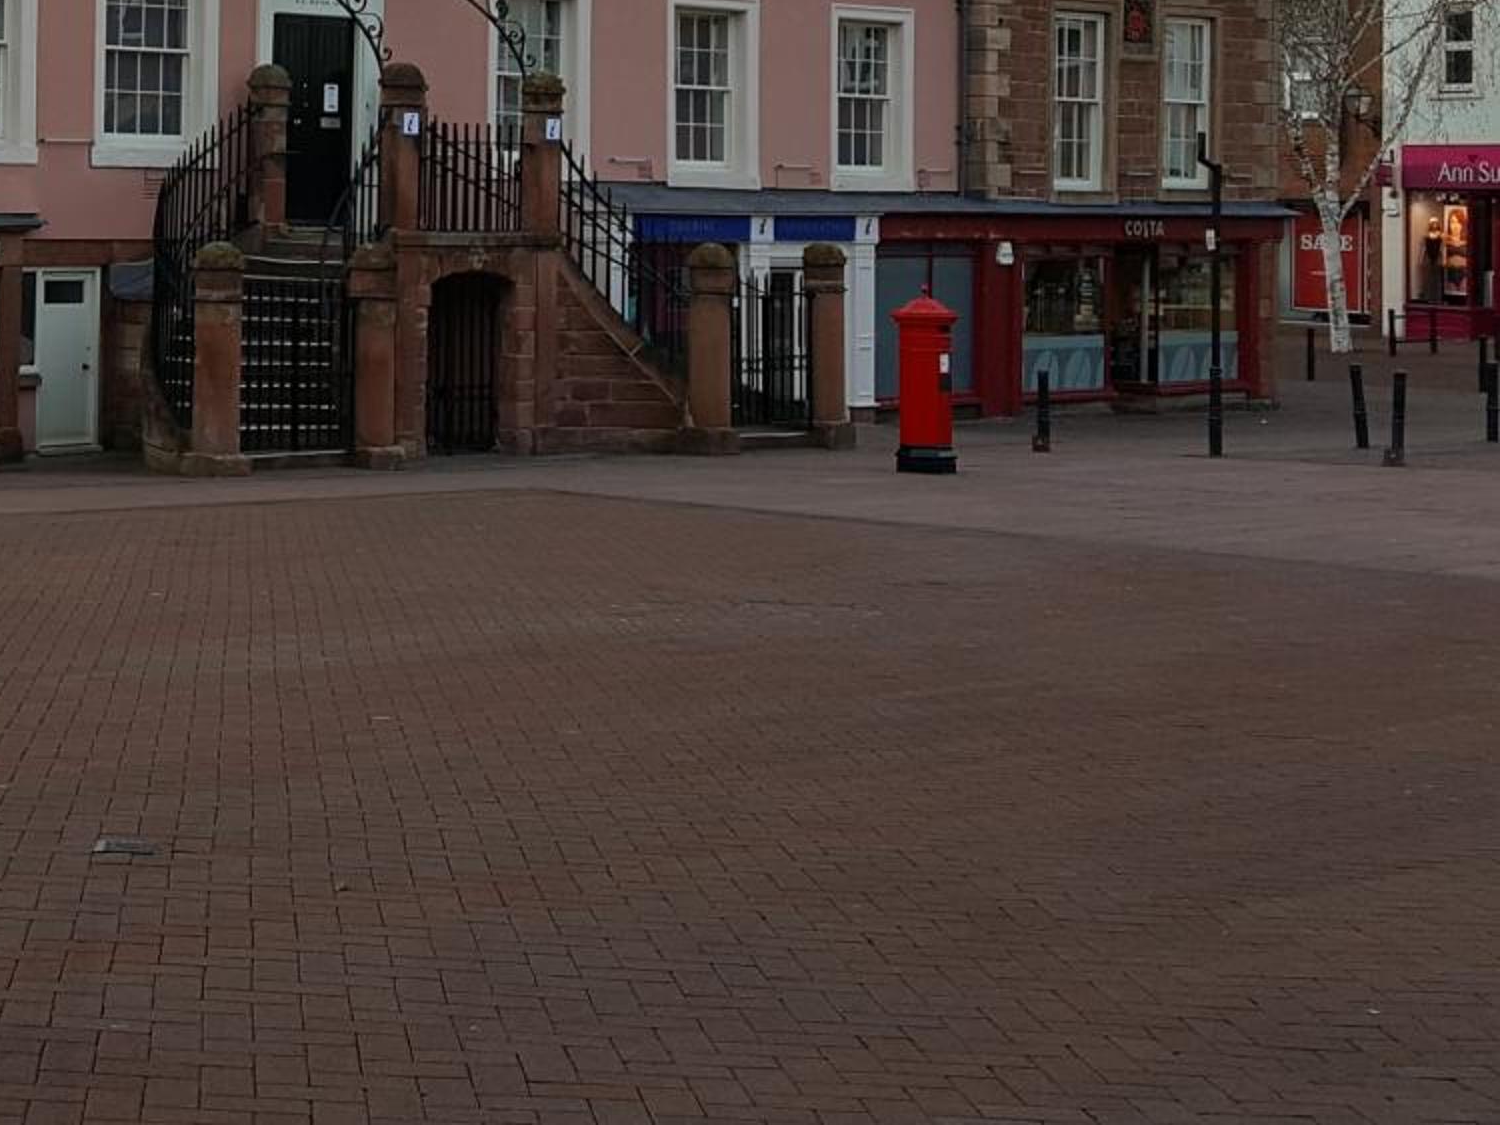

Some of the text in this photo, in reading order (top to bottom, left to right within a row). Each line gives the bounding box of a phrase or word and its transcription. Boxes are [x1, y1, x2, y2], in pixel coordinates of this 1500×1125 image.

[1437, 161, 1500, 183] Ann Su
[1125, 219, 1165, 237] COSTA
[1300, 234, 1353, 252] SAE
